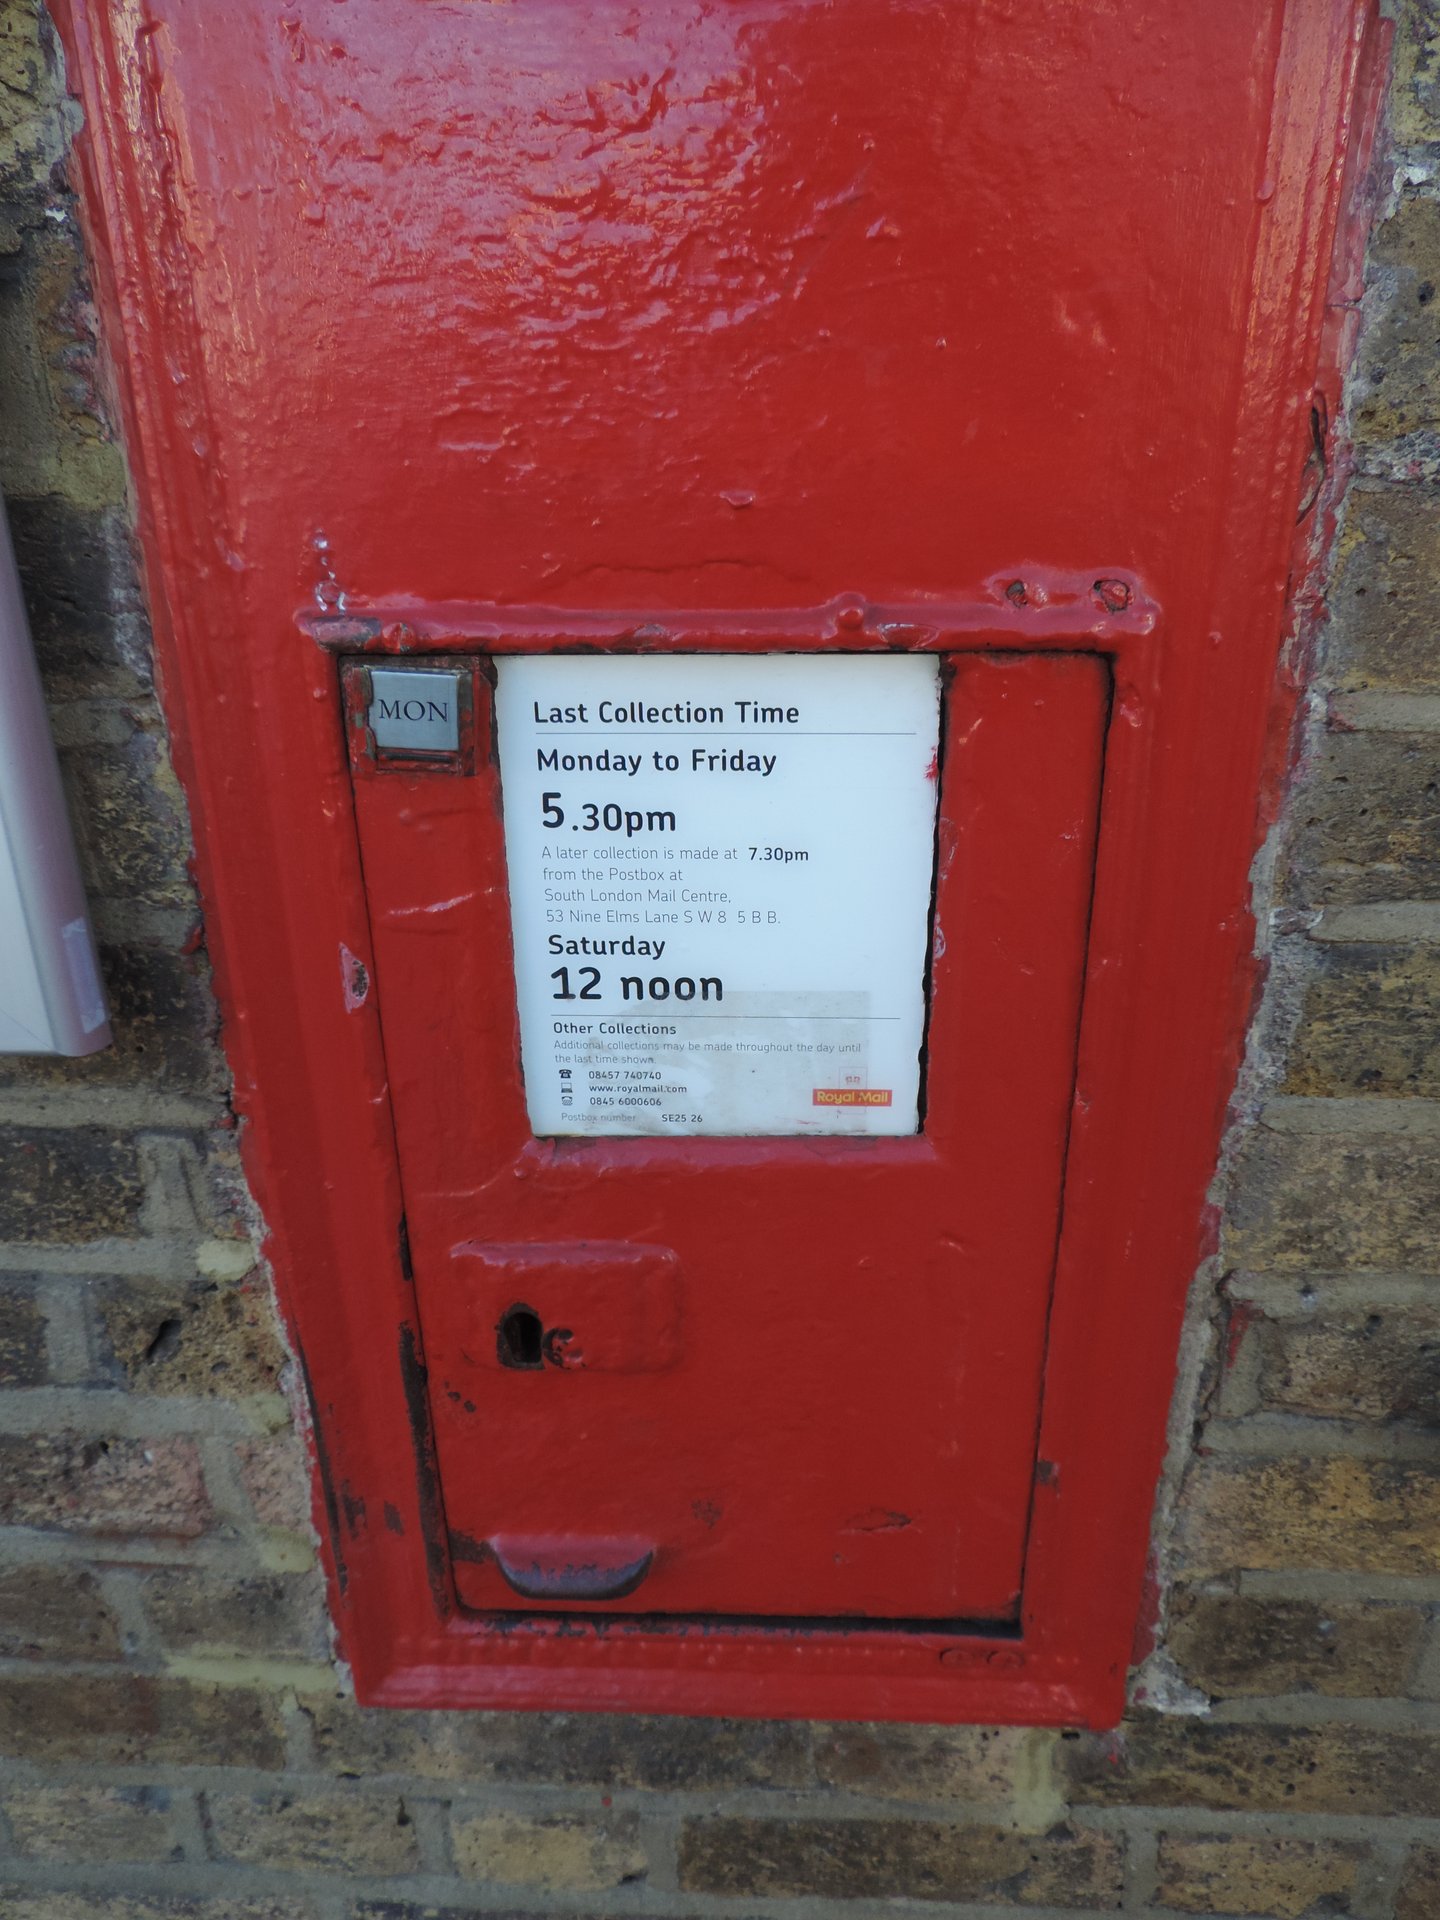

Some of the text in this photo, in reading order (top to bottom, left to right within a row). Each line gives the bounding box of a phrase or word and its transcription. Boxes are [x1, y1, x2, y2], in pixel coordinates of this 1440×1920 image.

[378, 699, 448, 722] MON
[534, 700, 800, 724] Last Collection Time
[536, 748, 777, 776] Monday to Friday
[542, 792, 676, 838] 5.30pm
[541, 846, 809, 864] A later collection is made at 7.30pm
[543, 867, 683, 881] from the Postbox at
[544, 888, 732, 904] South London Mail Centre,
[546, 910, 564, 923] 53
[569, 910, 601, 923] Nine
[607, 910, 640, 923] Elms
[645, 910, 679, 924] Lane
[548, 934, 666, 960] Saturday
[550, 966, 723, 1001] 12 noon
[553, 1022, 677, 1034] Other Collections
[554, 1040, 861, 1053] Additional collections may be made throughout the day until
[555, 1054, 571, 1063] the
[574, 1055, 593, 1063] last
[595, 1055, 618, 1063] time
[588, 1071, 662, 1079] 08457 740740
[589, 1085, 687, 1093] www.royalmail.com
[590, 1097, 662, 1106] 0845 6000606
[817, 1091, 888, 1104] Royal Mail
[561, 1113, 703, 1123] Postbox number SE25 26
